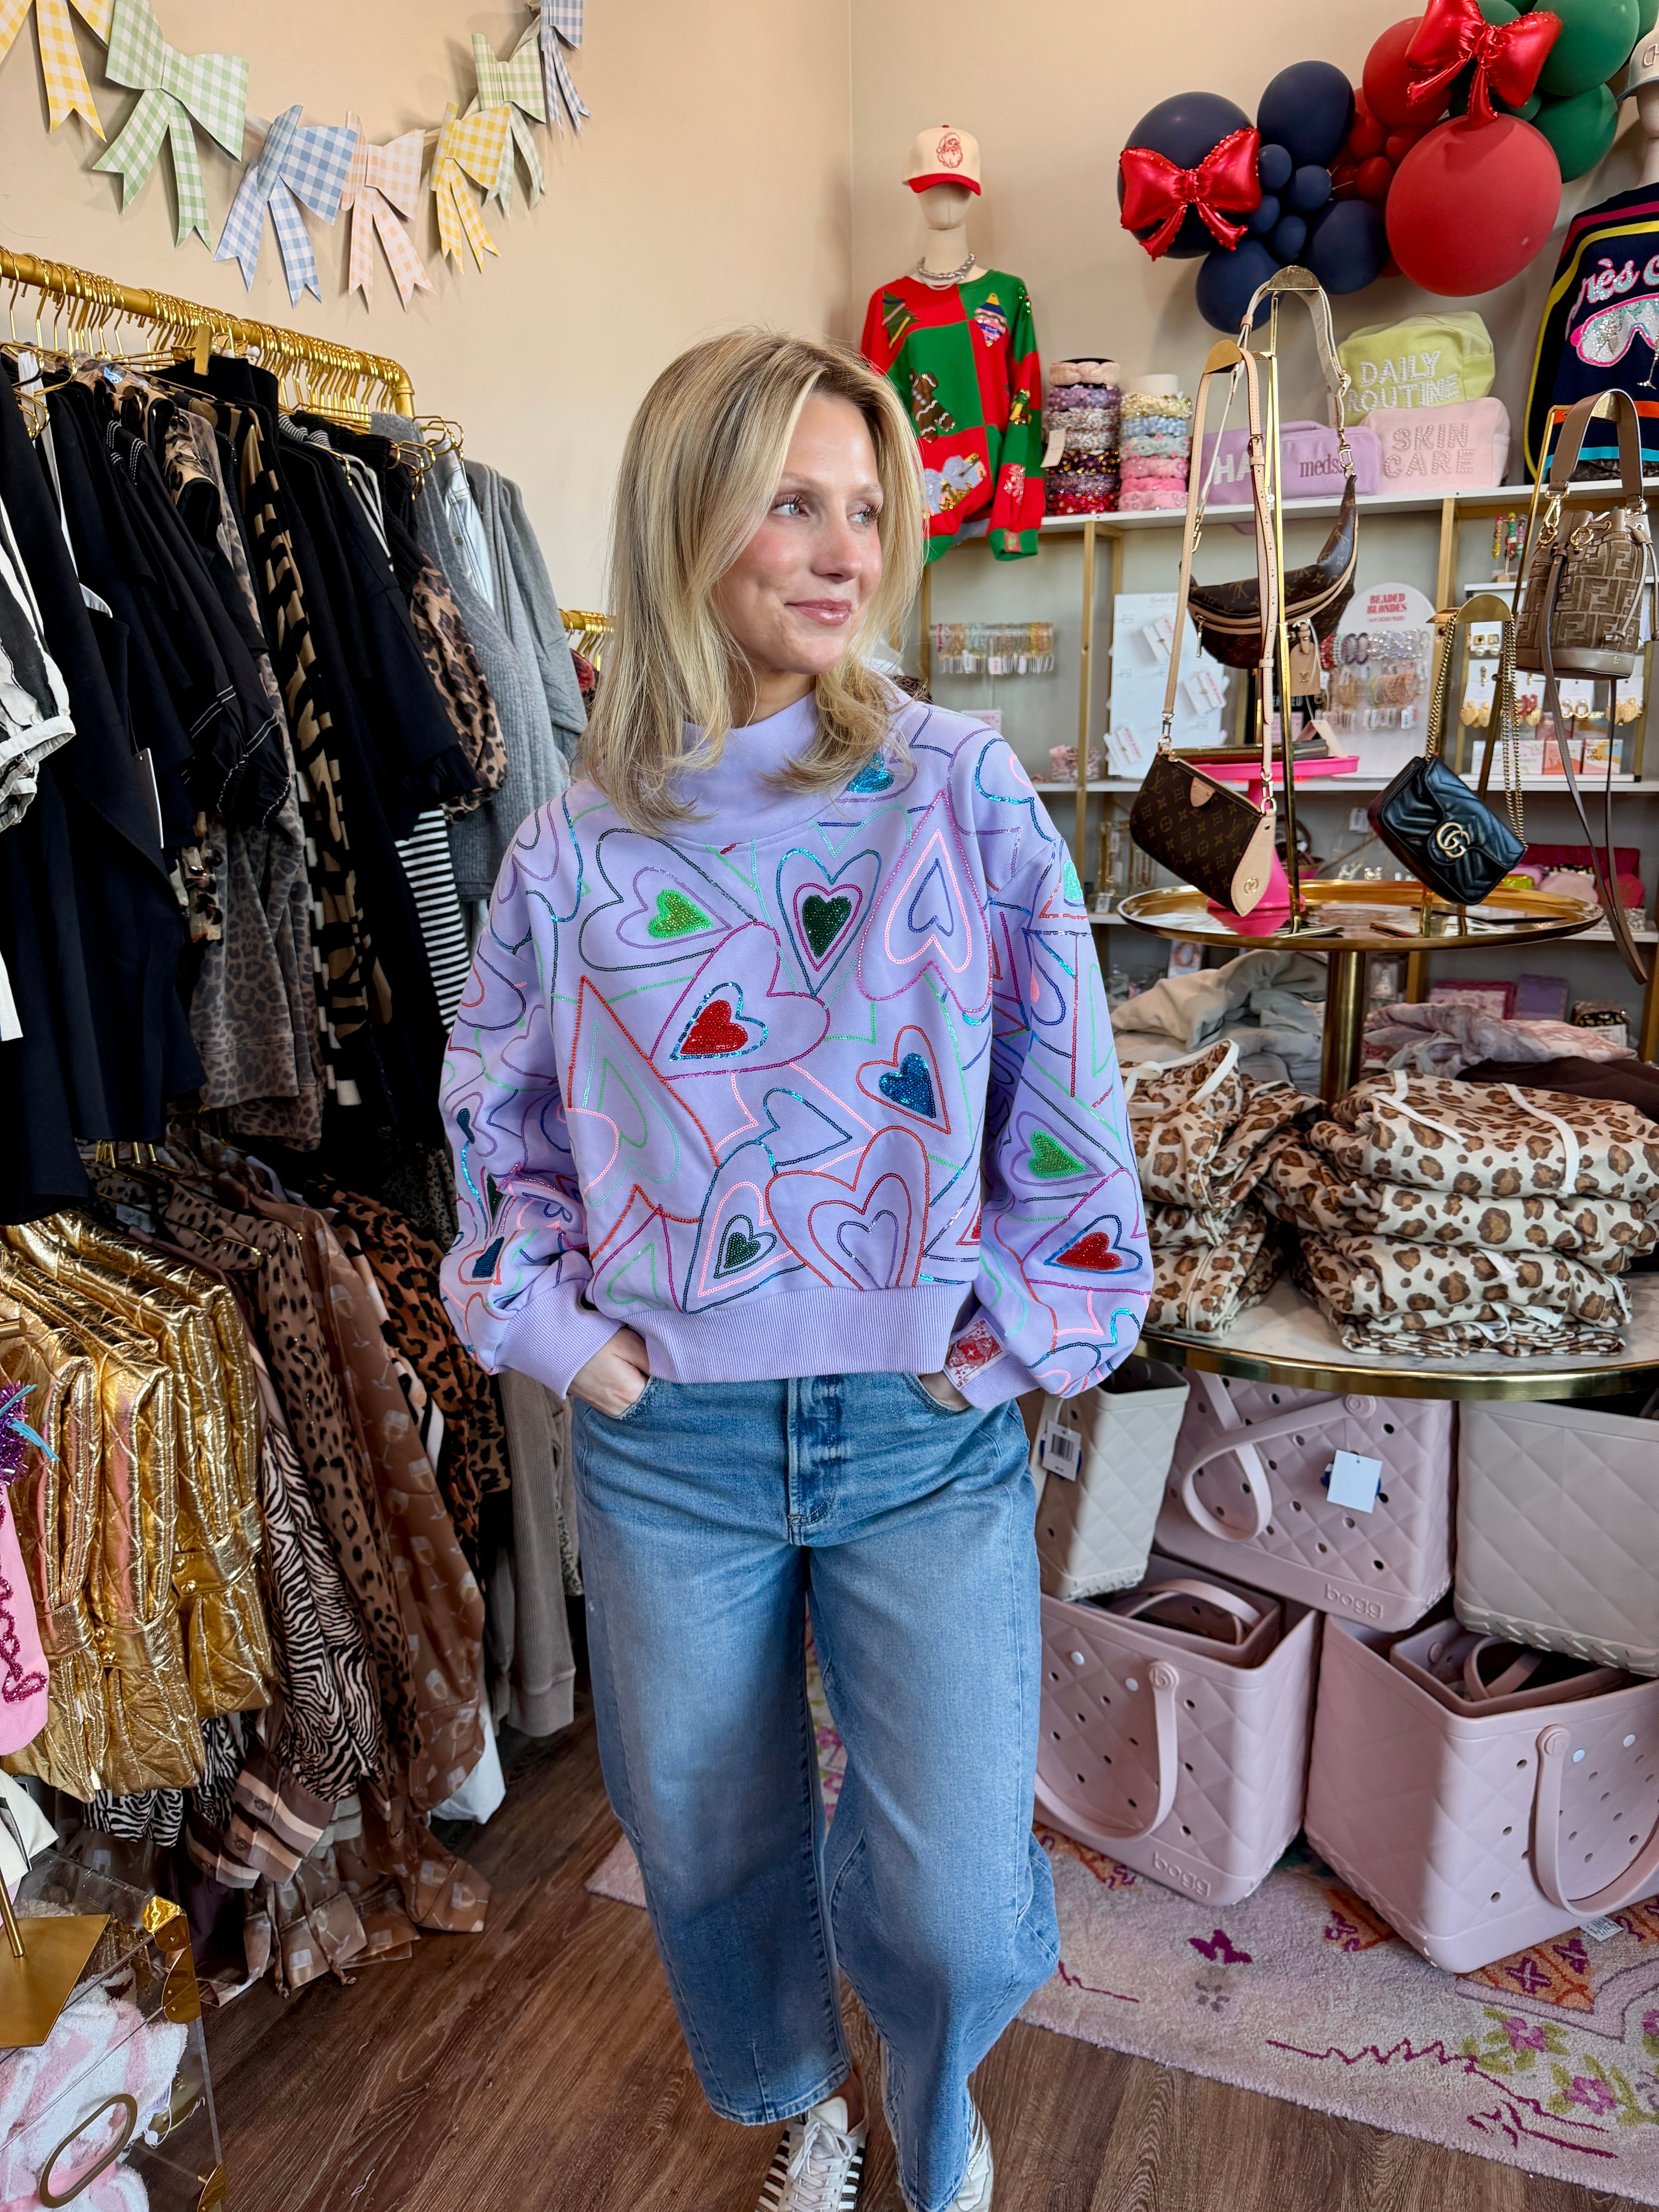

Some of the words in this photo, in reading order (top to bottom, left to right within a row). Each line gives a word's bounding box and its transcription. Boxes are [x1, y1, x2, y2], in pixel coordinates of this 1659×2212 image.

[1360, 350, 1441, 386] DAILY
[1347, 373, 1460, 413] ROUTINE
[1392, 423, 1468, 452] SKIN
[1383, 449, 1474, 479] CARE
[1367, 604, 1407, 614] BLONDES
[1370, 593, 1406, 604] BEADED
[1324, 1583, 1384, 1619] bogg
[1152, 1852, 1211, 1897] bogg
